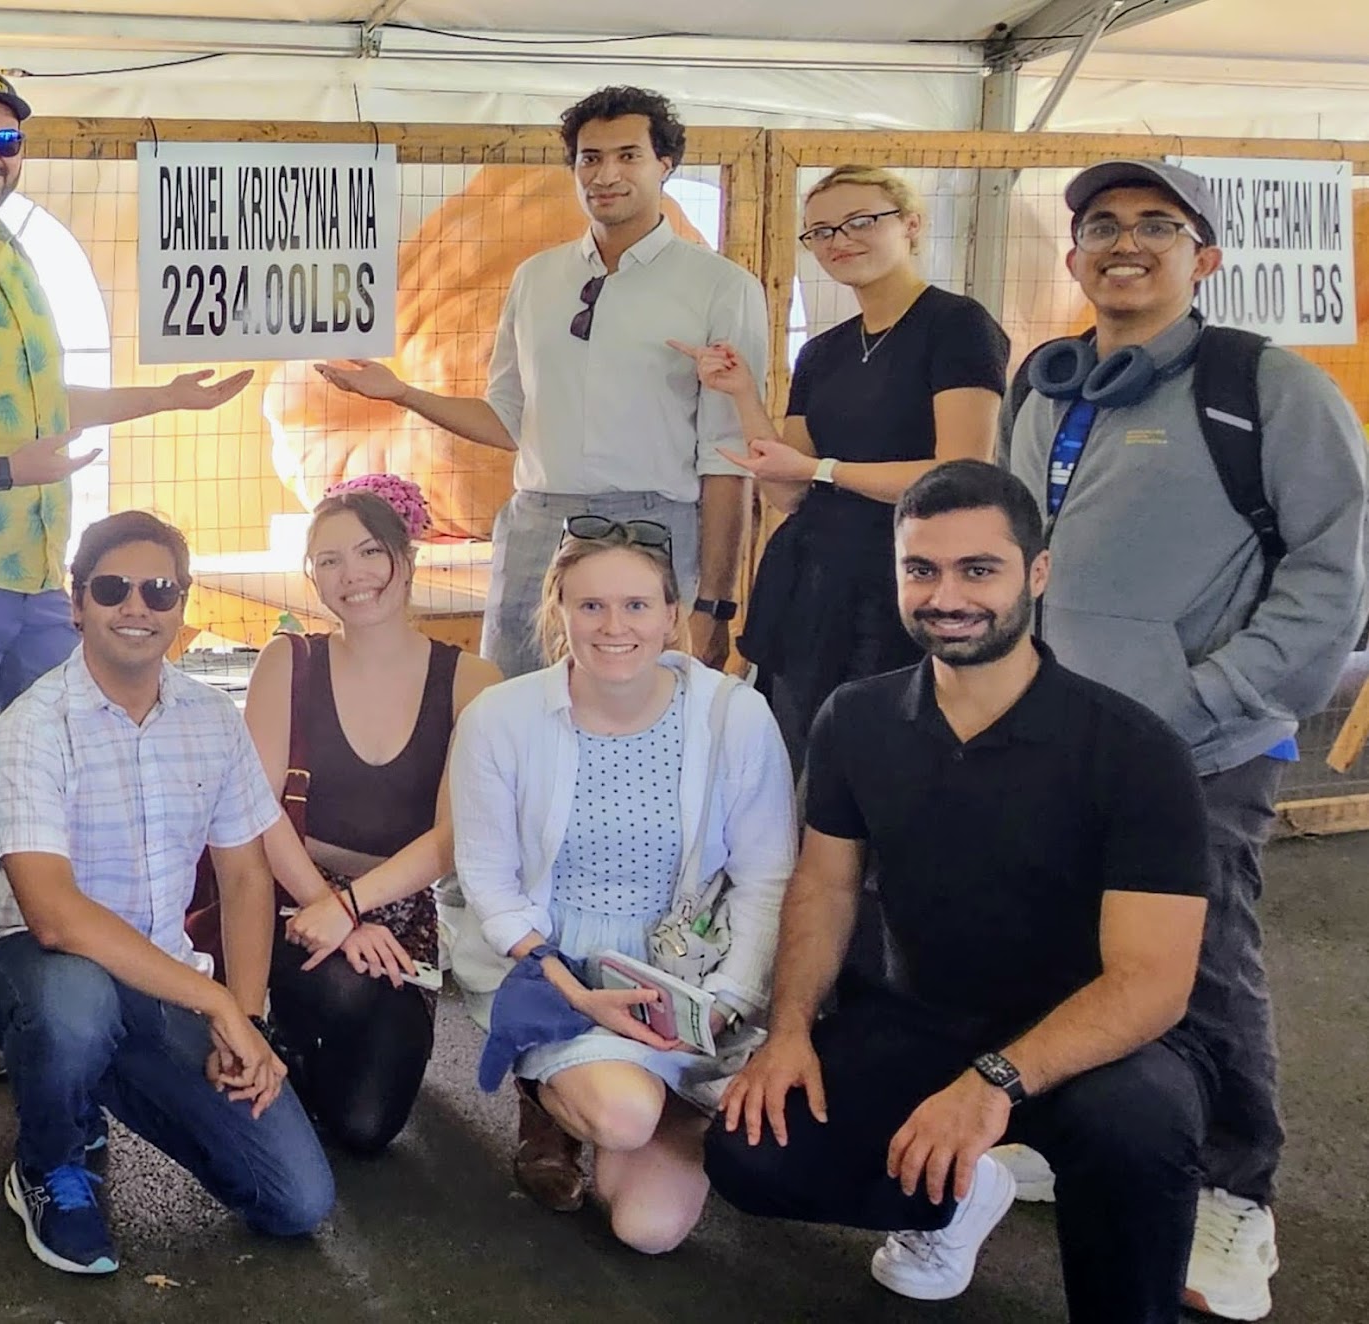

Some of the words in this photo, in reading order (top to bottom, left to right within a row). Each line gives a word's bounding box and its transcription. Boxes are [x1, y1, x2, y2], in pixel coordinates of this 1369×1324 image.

[160, 166, 229, 250] DANIEL
[238, 165, 340, 251] KRUSZYNA
[349, 167, 377, 249] MA
[1202, 177, 1245, 249] MAS
[1252, 179, 1312, 249] KEENAN
[1319, 182, 1342, 250] MA
[162, 262, 375, 336] 2234.00LBS
[1198, 262, 1285, 325] 000.00
[1298, 264, 1343, 324] LBS
